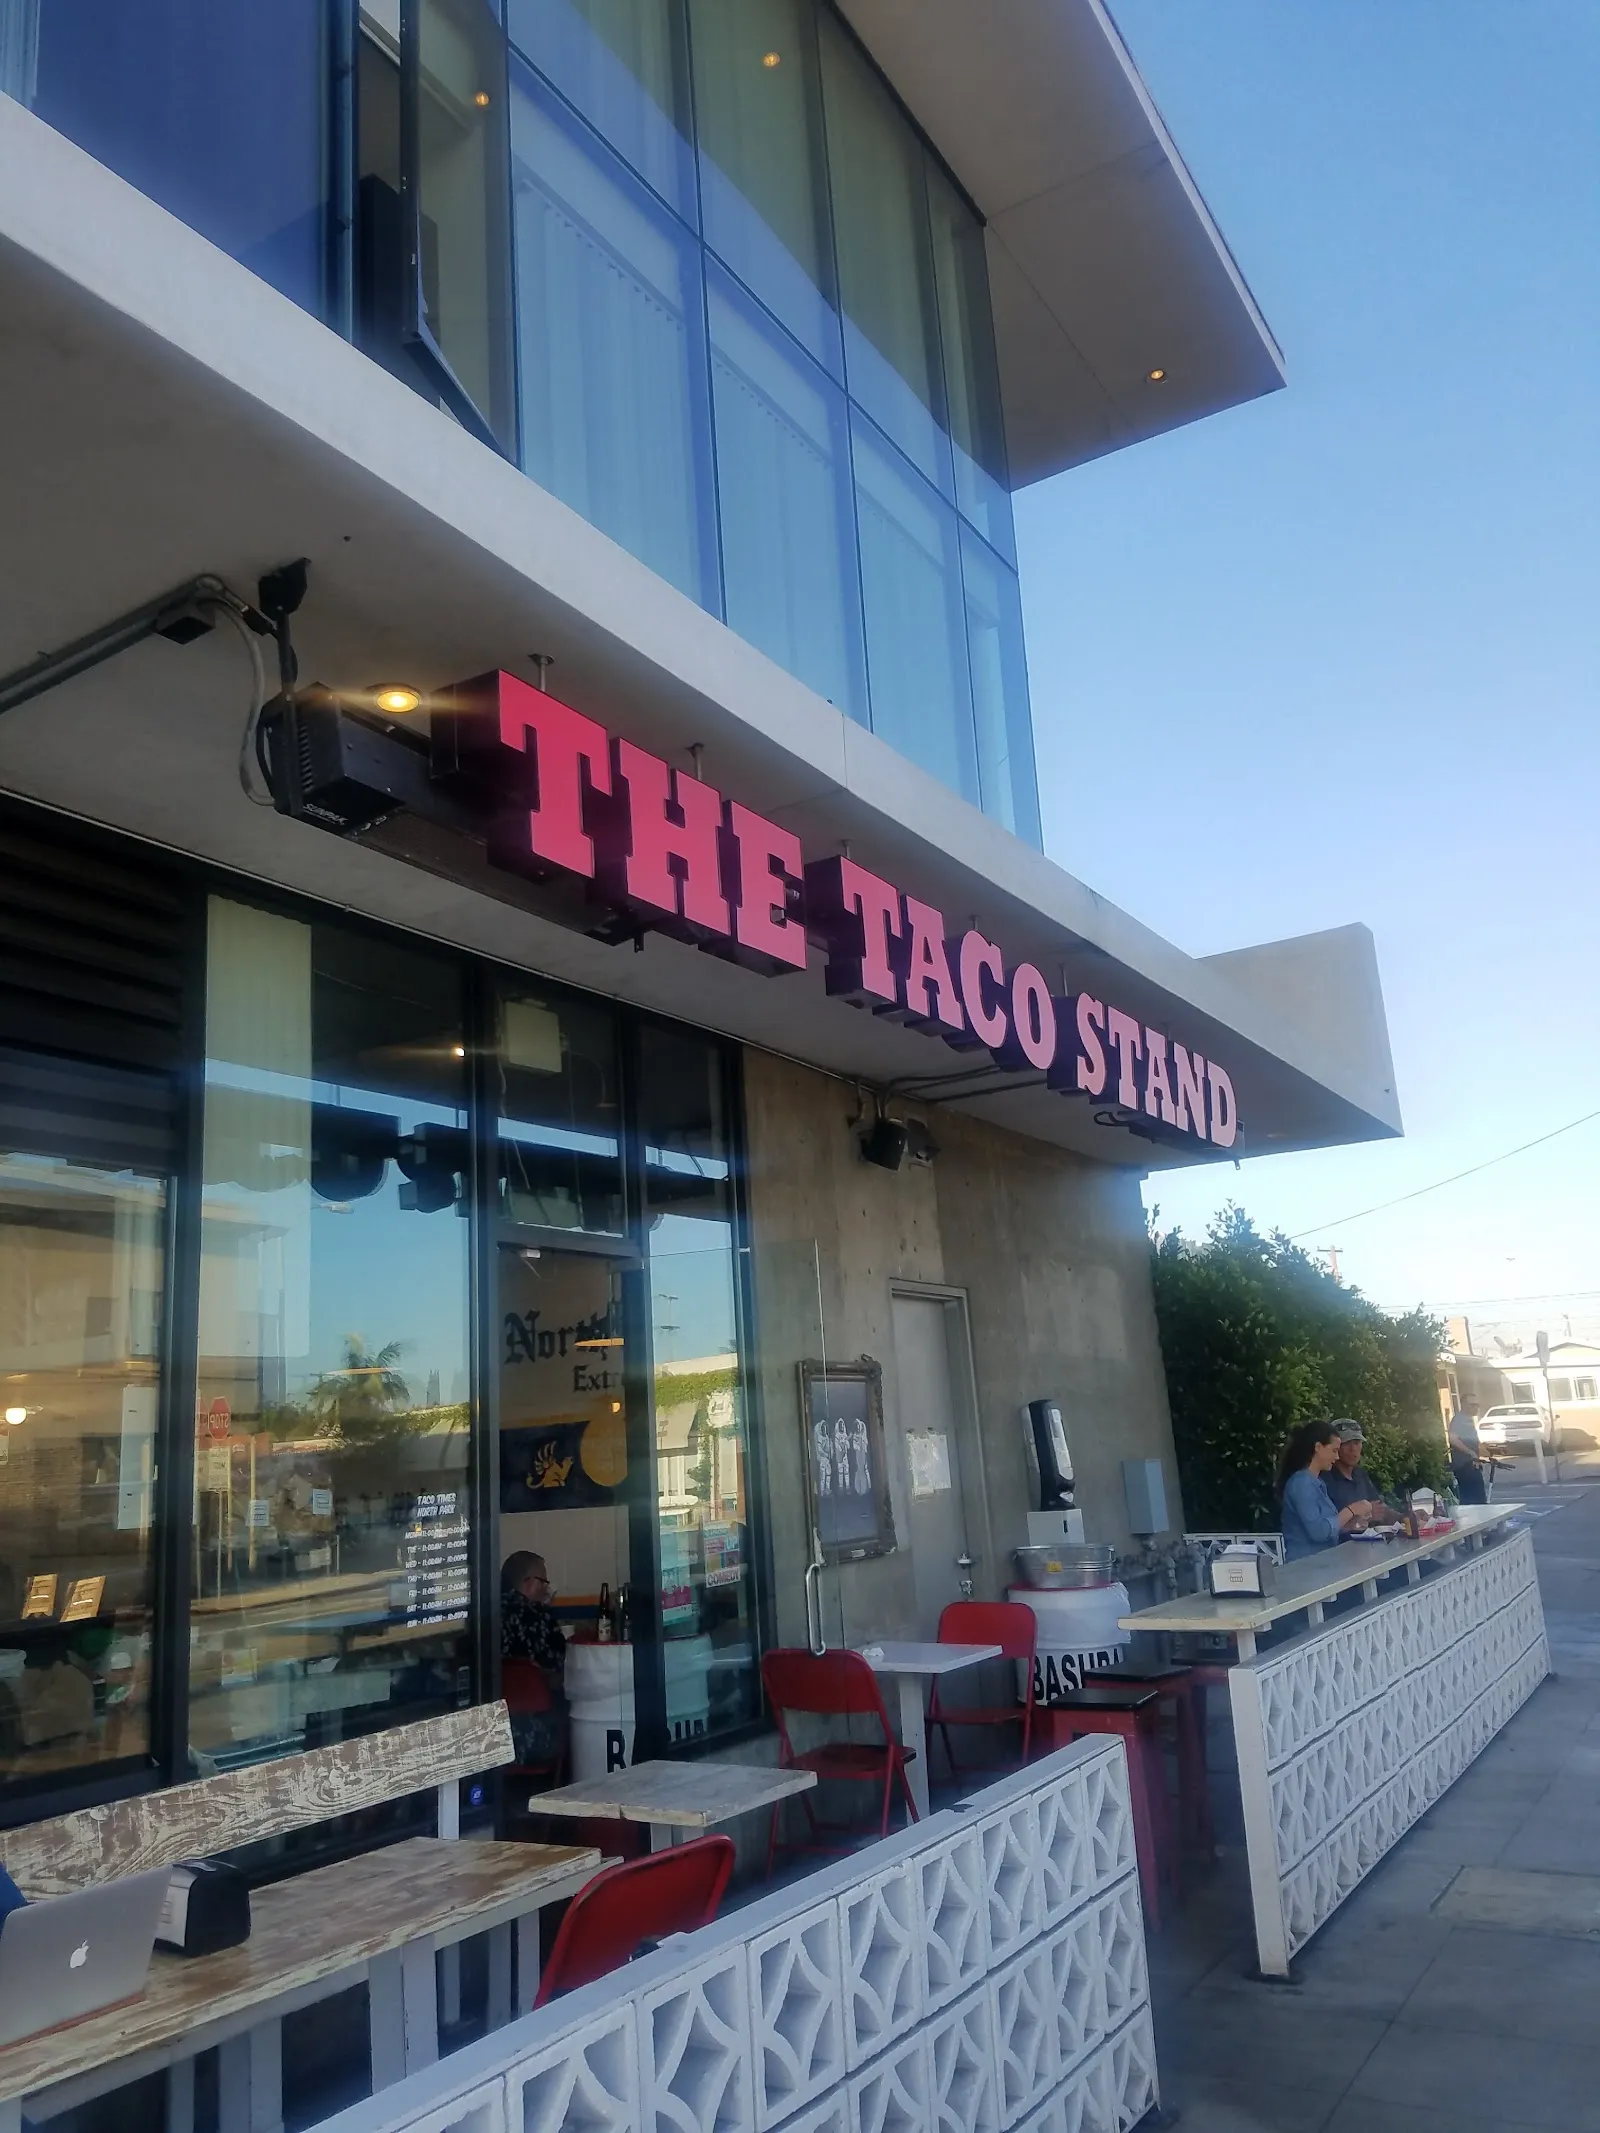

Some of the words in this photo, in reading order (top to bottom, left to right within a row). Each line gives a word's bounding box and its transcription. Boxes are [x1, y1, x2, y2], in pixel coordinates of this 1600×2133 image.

[499, 668, 807, 970] THE
[841, 855, 1057, 1070] TACO
[1076, 993, 1238, 1148] STAND
[417, 1494, 435, 1505] TACO
[437, 1492, 456, 1503] TIMES
[417, 1506, 438, 1517] NORTH
[439, 1504, 456, 1515] PARK
[407, 1545, 417, 1554] TUE
[405, 1560, 417, 1569] WED
[406, 1604, 417, 1613] SAT
